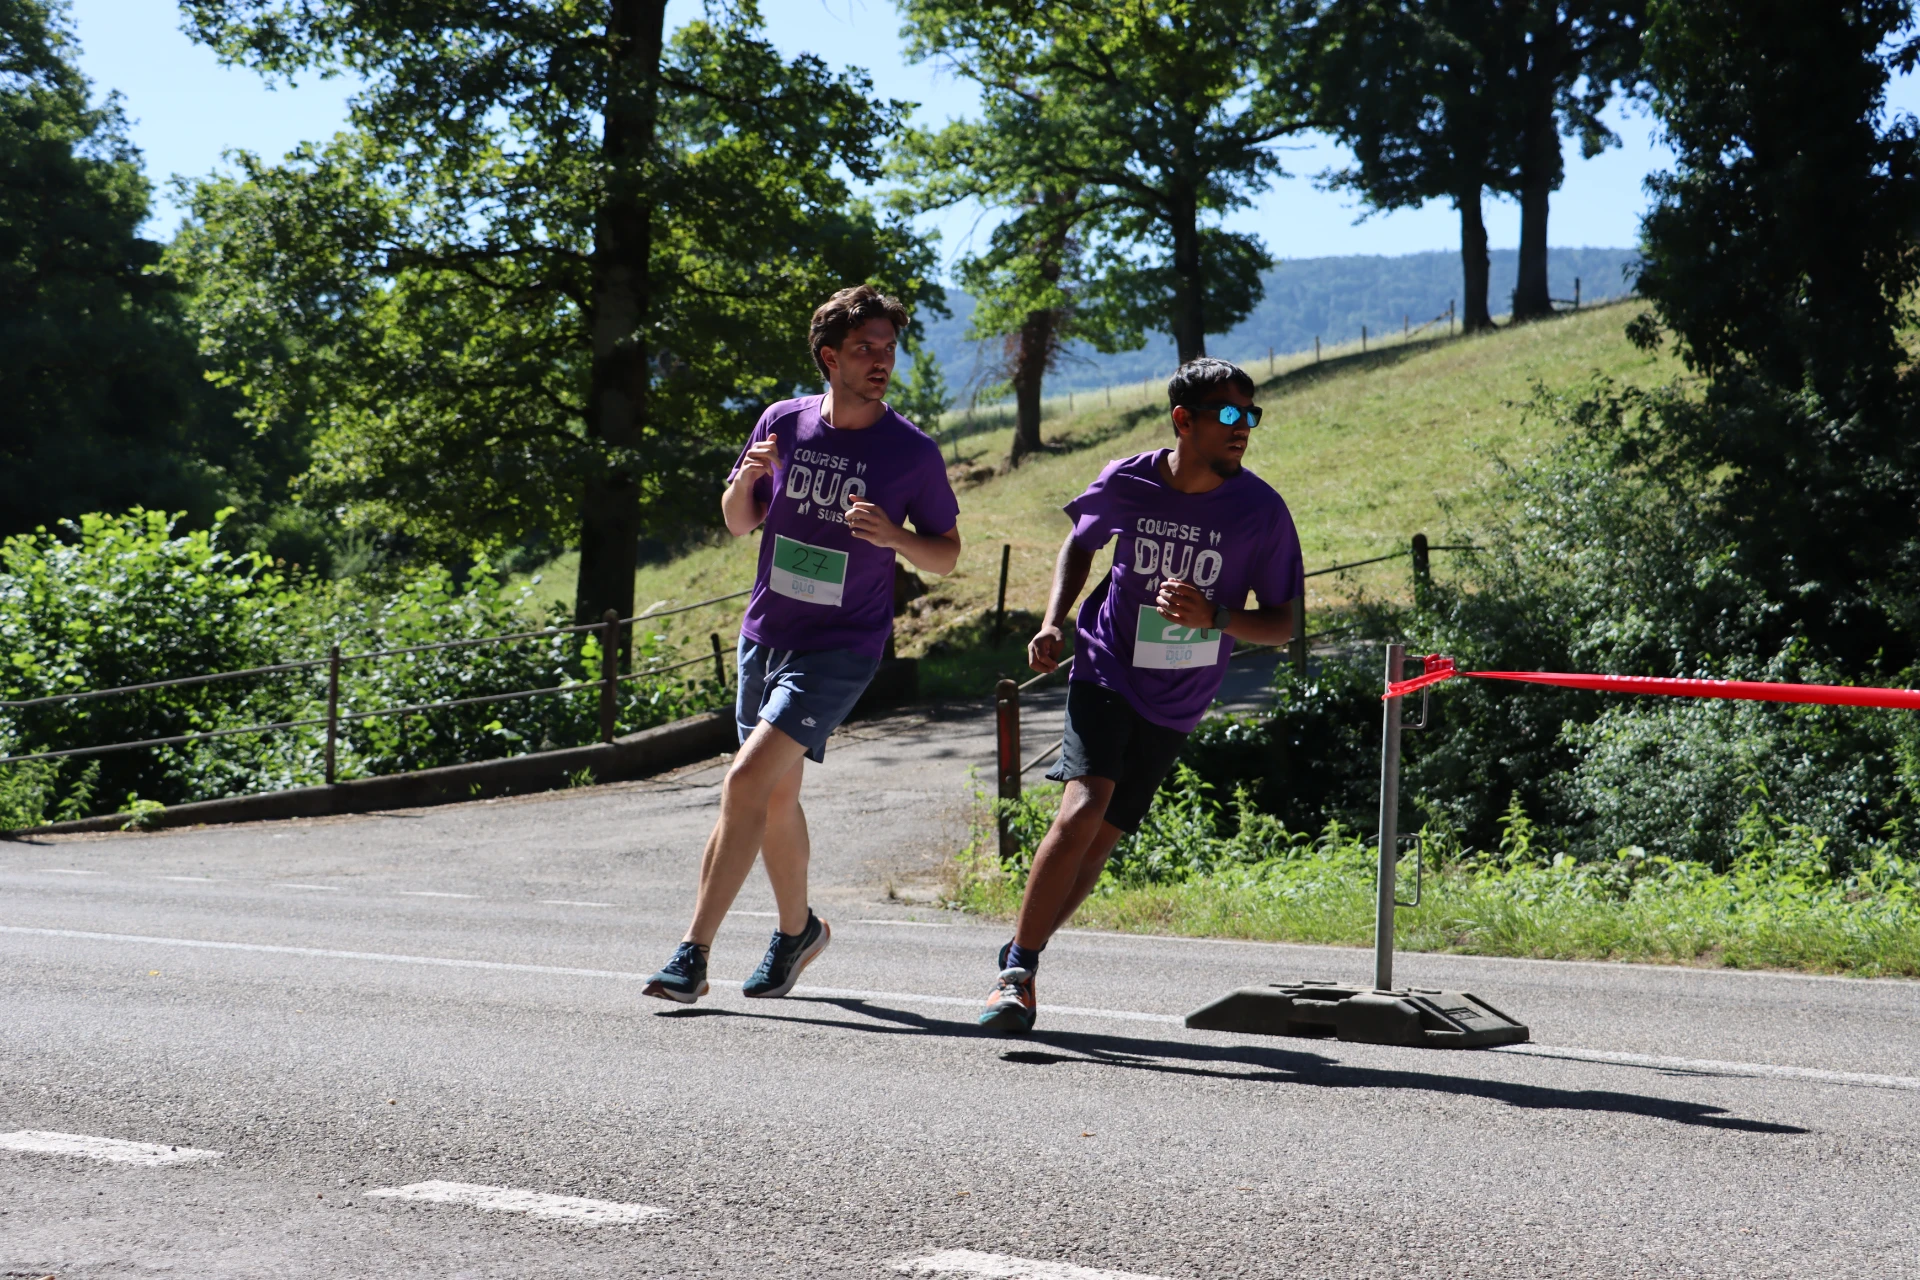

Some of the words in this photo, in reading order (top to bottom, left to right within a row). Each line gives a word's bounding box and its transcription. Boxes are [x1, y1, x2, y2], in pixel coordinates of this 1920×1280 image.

[793, 448, 850, 471] COURSE
[785, 464, 867, 512] DUO
[817, 508, 850, 525] SUIS
[1136, 517, 1202, 542] COURSE
[791, 547, 829, 575] 27
[1132, 536, 1223, 587] DUO
[791, 579, 815, 595] DUO
[1165, 649, 1193, 661] DUO
